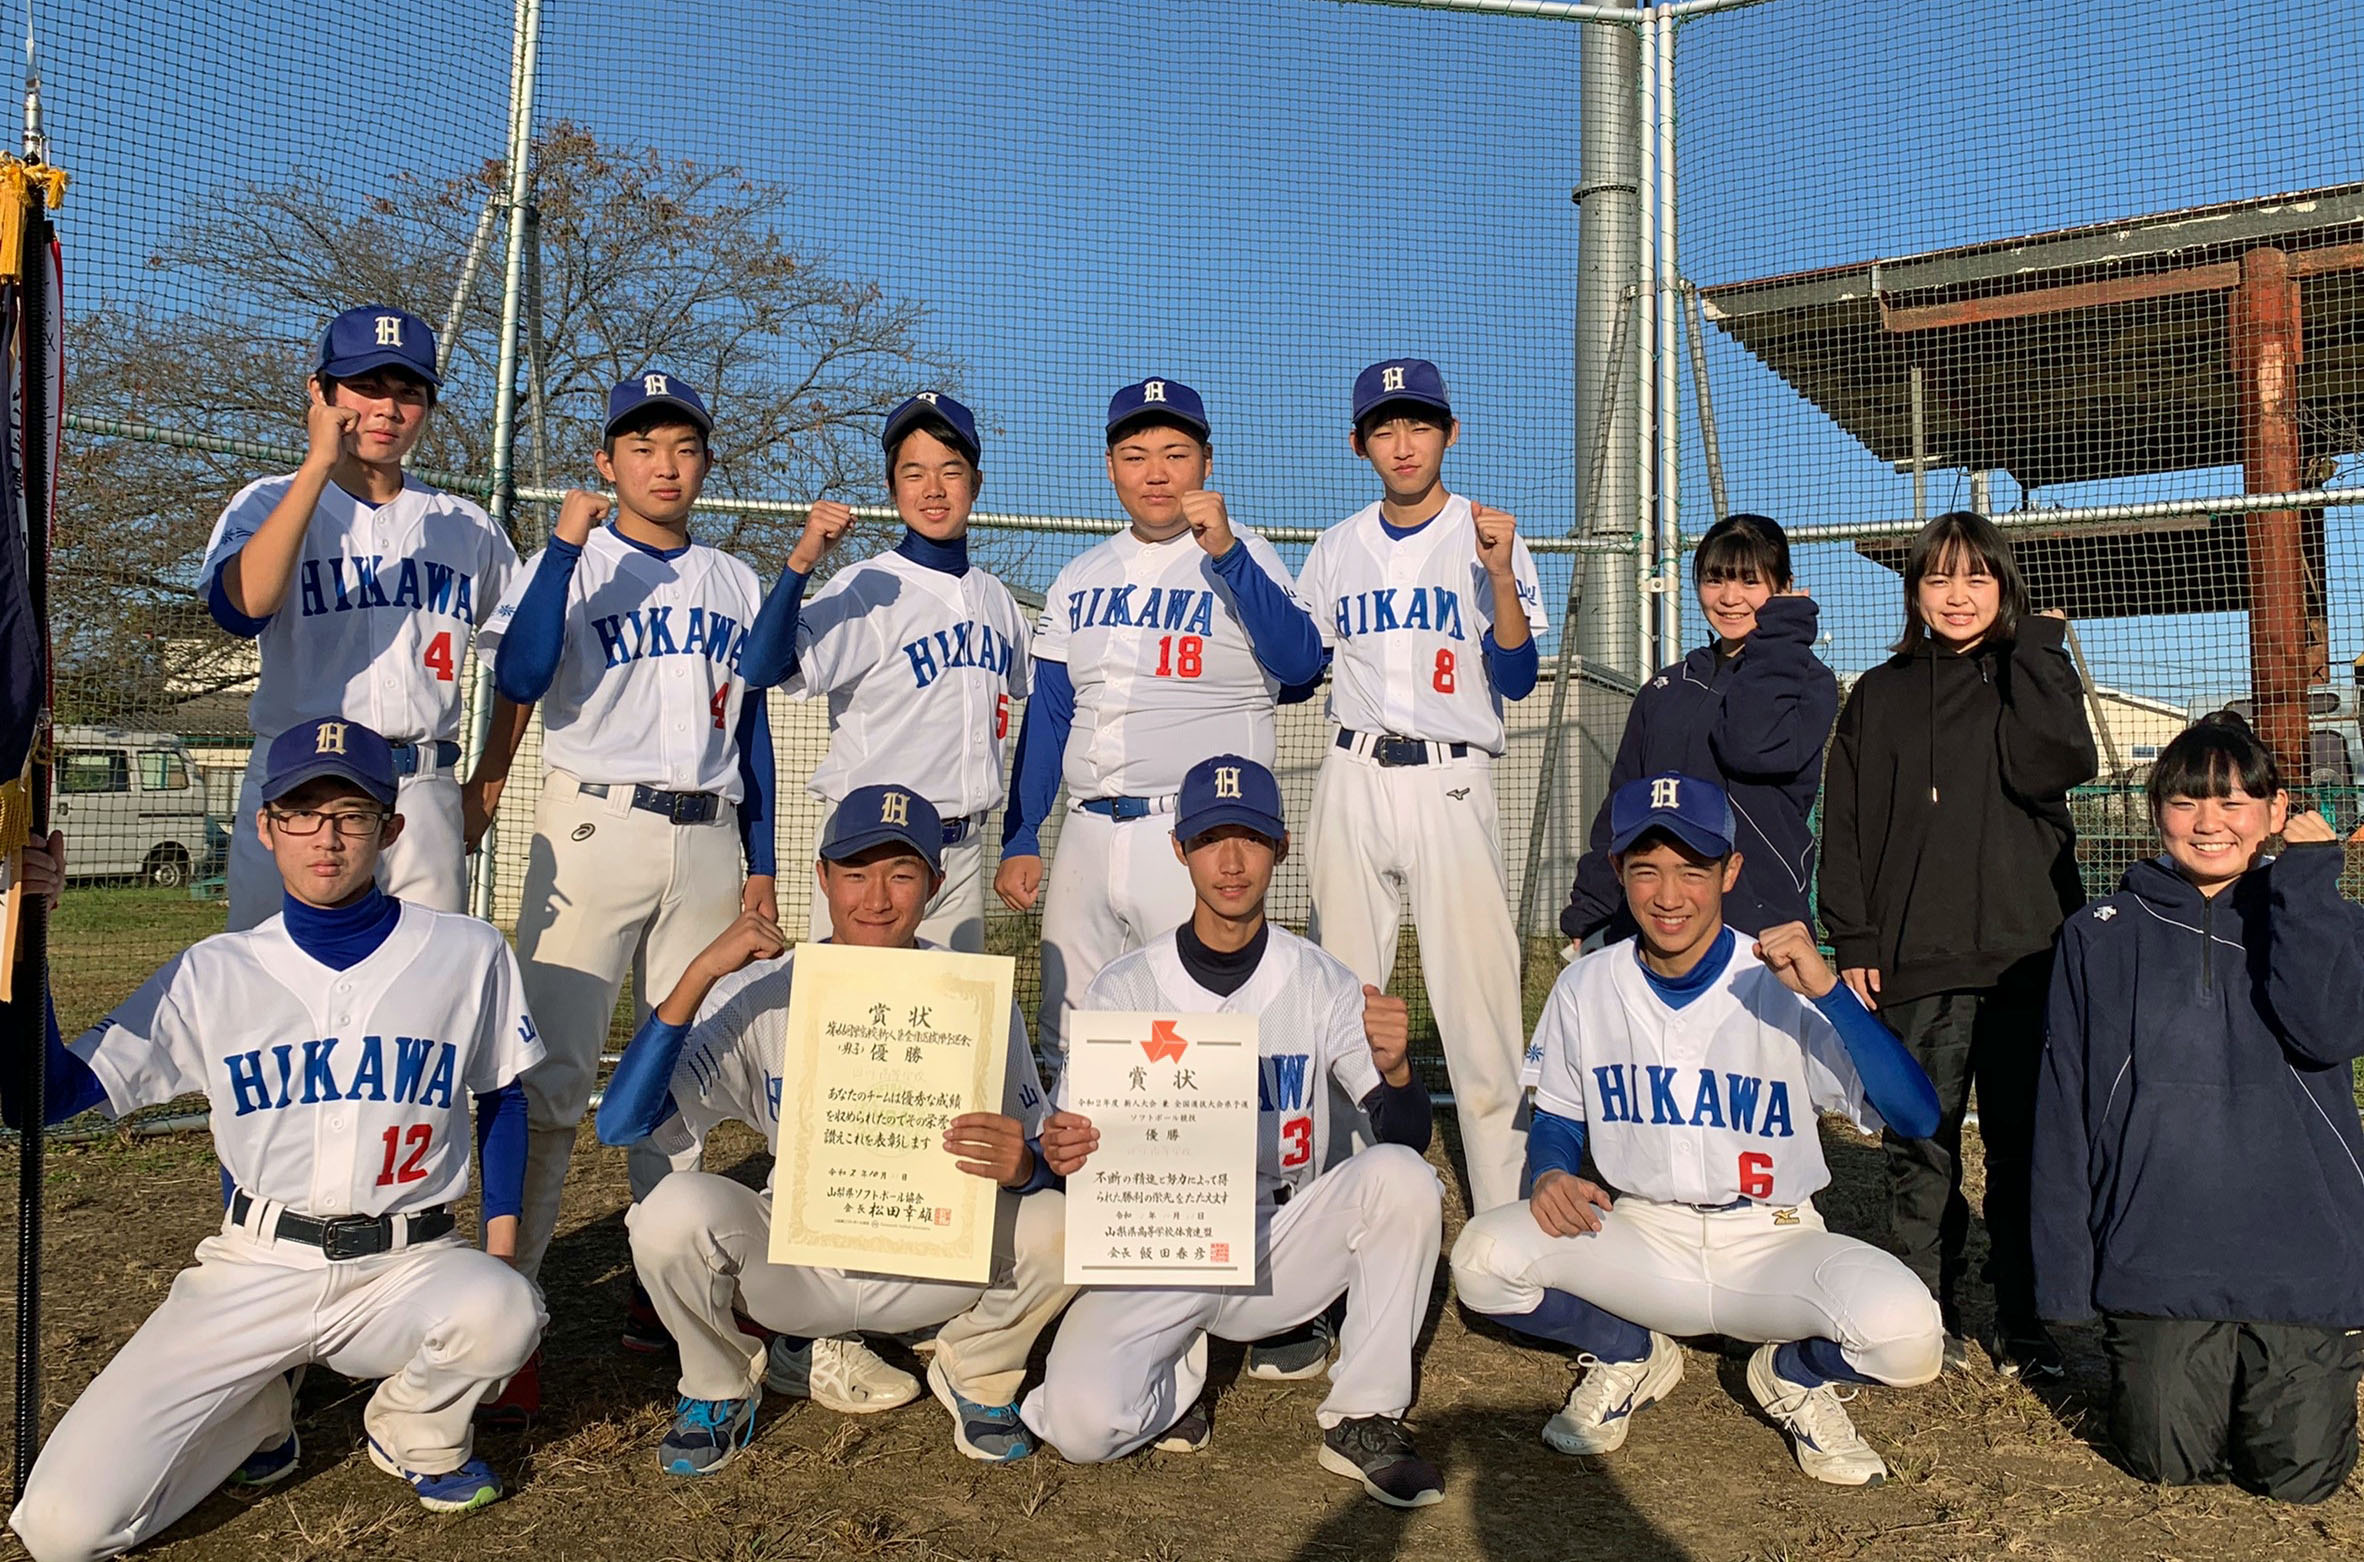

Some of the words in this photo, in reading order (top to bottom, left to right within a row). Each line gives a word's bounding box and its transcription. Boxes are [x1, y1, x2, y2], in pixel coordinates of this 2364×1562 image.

[375, 316, 403, 347] H
[644, 374, 670, 396] H
[1144, 381, 1166, 402] H
[1382, 367, 1406, 392] H
[302, 555, 473, 625] HIKAWA
[1069, 584, 1213, 636] HIKAWA
[1336, 586, 1466, 640] HIKAWA
[424, 631, 453, 681] 4
[1156, 635, 1203, 678] 18
[1433, 648, 1455, 694] 8
[710, 682, 729, 729] 4
[995, 693, 1009, 739] 5
[315, 722, 349, 755] H
[1214, 766, 1242, 799] H
[1650, 778, 1680, 808] H
[880, 792, 910, 827] H
[868, 1003, 932, 1029] 賞状
[870, 1043, 923, 1064] 優勝
[223, 1035, 457, 1117] HIKAWA
[1129, 1066, 1198, 1092] 賞状
[1592, 1064, 1794, 1138] HIKAWA
[1146, 1128, 1180, 1142] 優勝
[1282, 1116, 1312, 1167] 3
[376, 1124, 433, 1186] 12
[1738, 1151, 1774, 1199] 6
[826, 1187, 925, 1204] 山梨県ソフトボール協会
[843, 1202, 866, 1215] 会長
[868, 1202, 933, 1222] 松田幸雄
[1105, 1226, 1213, 1238] 山梨県高等学校体育連盟
[1107, 1246, 1132, 1259] 会長
